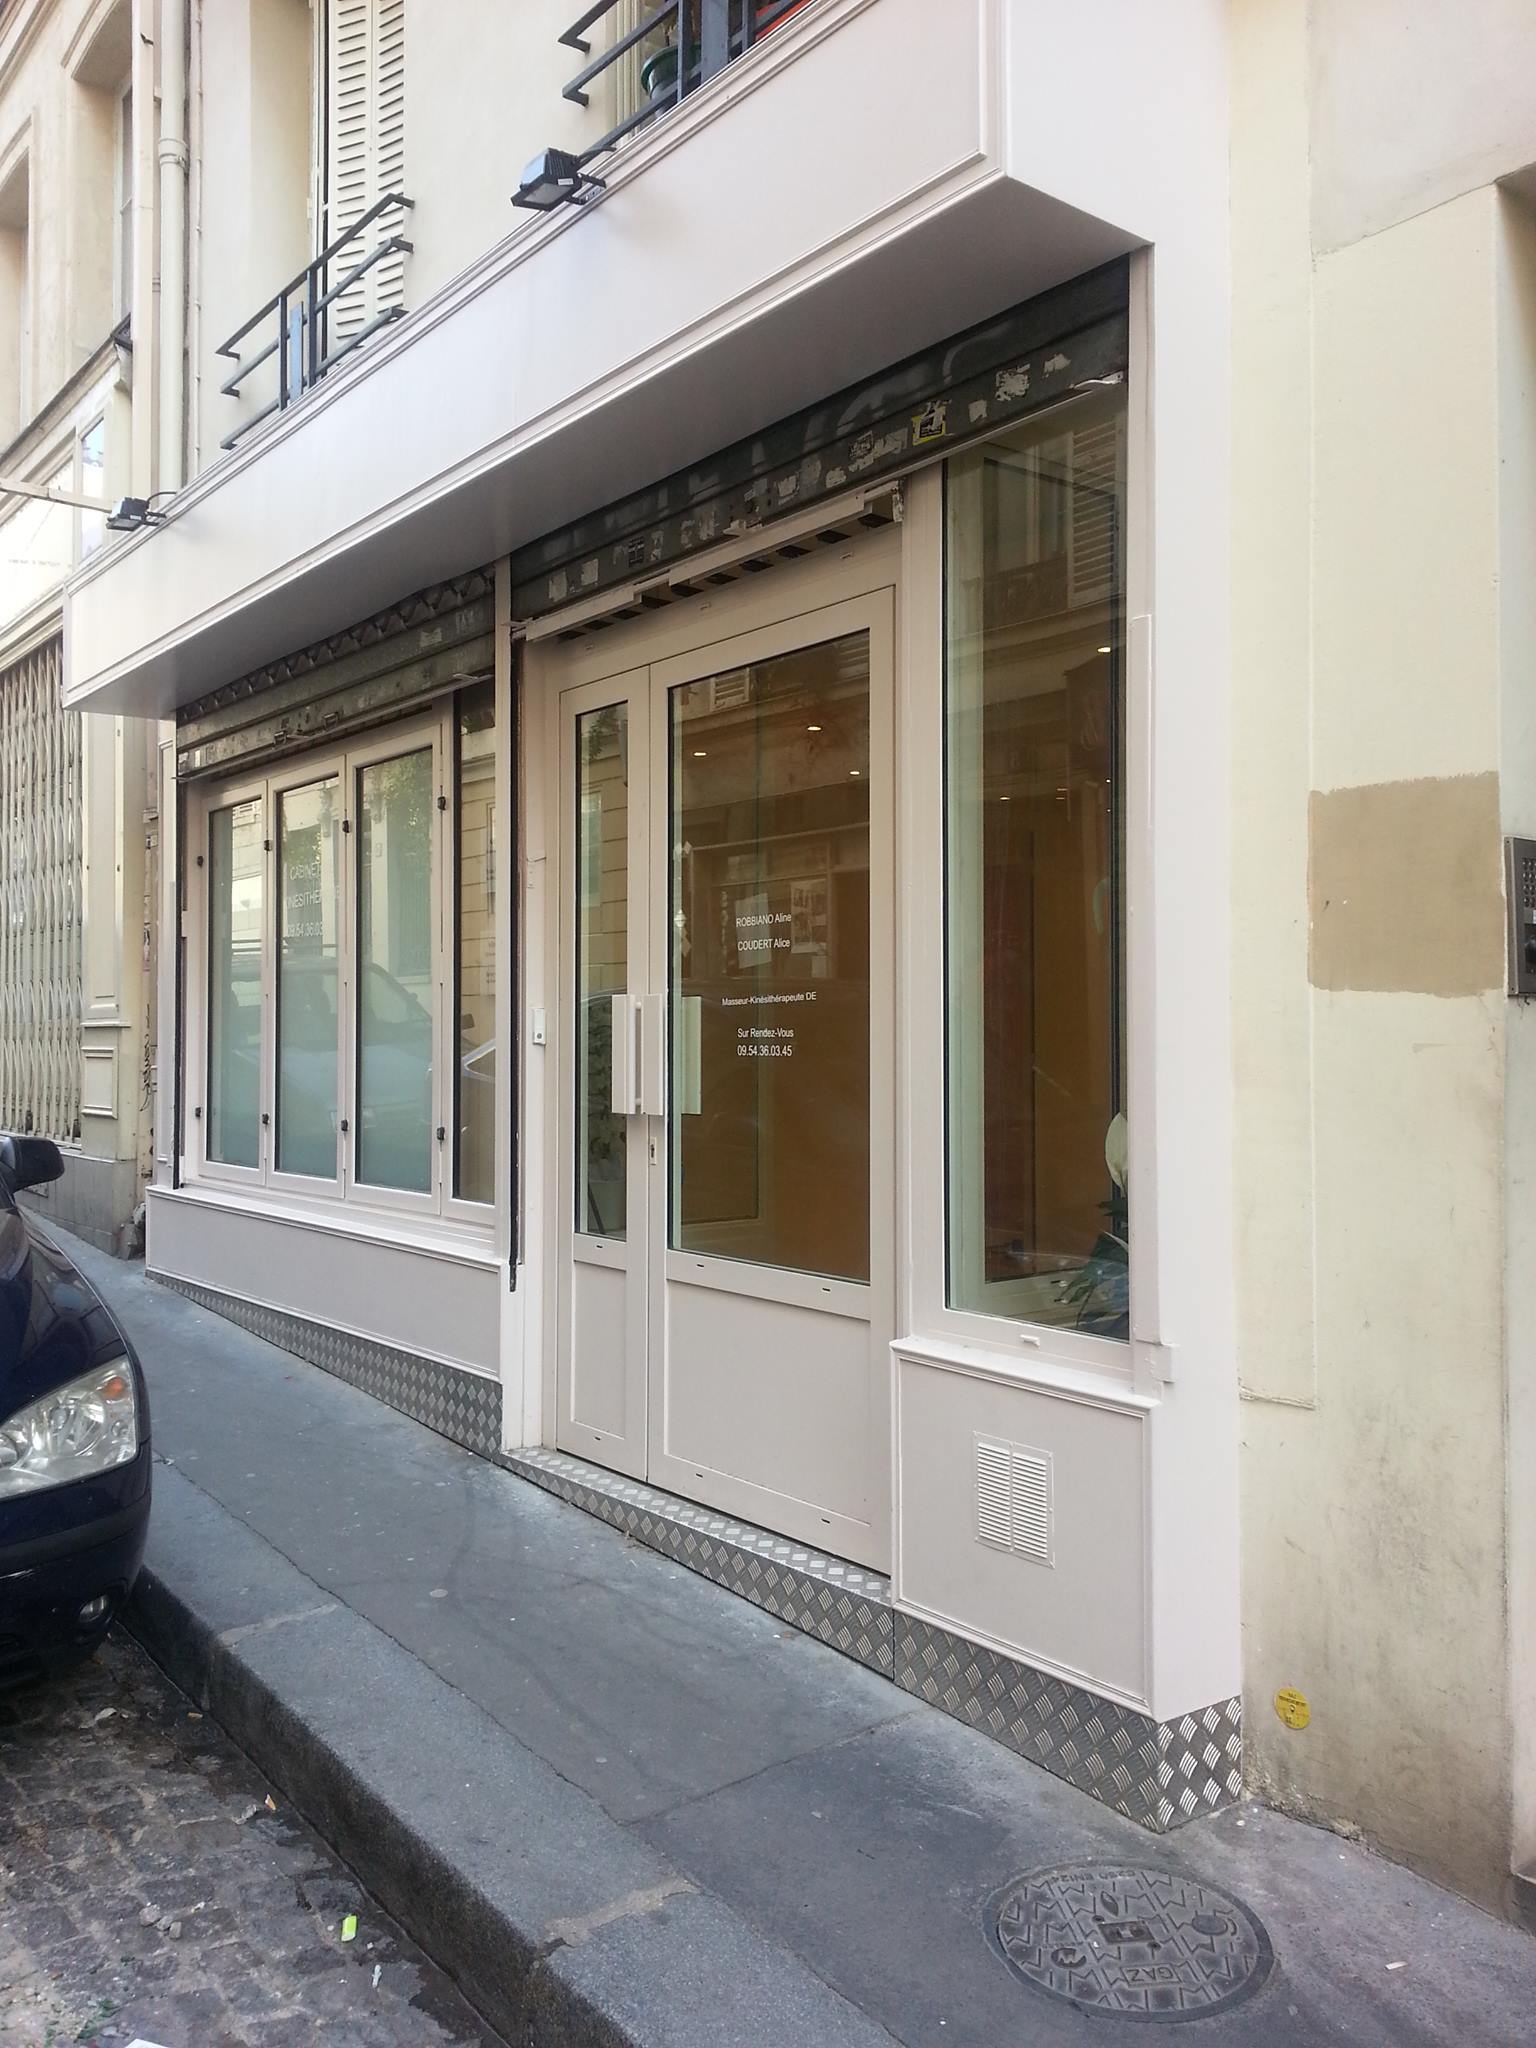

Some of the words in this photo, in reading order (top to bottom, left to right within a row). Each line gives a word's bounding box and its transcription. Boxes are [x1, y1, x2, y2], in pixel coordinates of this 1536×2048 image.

[290, 861, 321, 880] CABINET
[736, 914, 774, 928] ROBBIANO
[775, 912, 792, 923] Aline
[737, 938, 773, 951] COUDERT
[774, 938, 791, 948] Alice
[722, 994, 804, 1006] Masseur-Kinésithérapeute
[805, 991, 817, 1001] DE
[737, 1028, 749, 1038] Sur
[750, 1027, 794, 1038] Rendez-Vous
[737, 1045, 792, 1056] 09.54.36.03.45
[1126, 1966, 1174, 1982] GAZ
